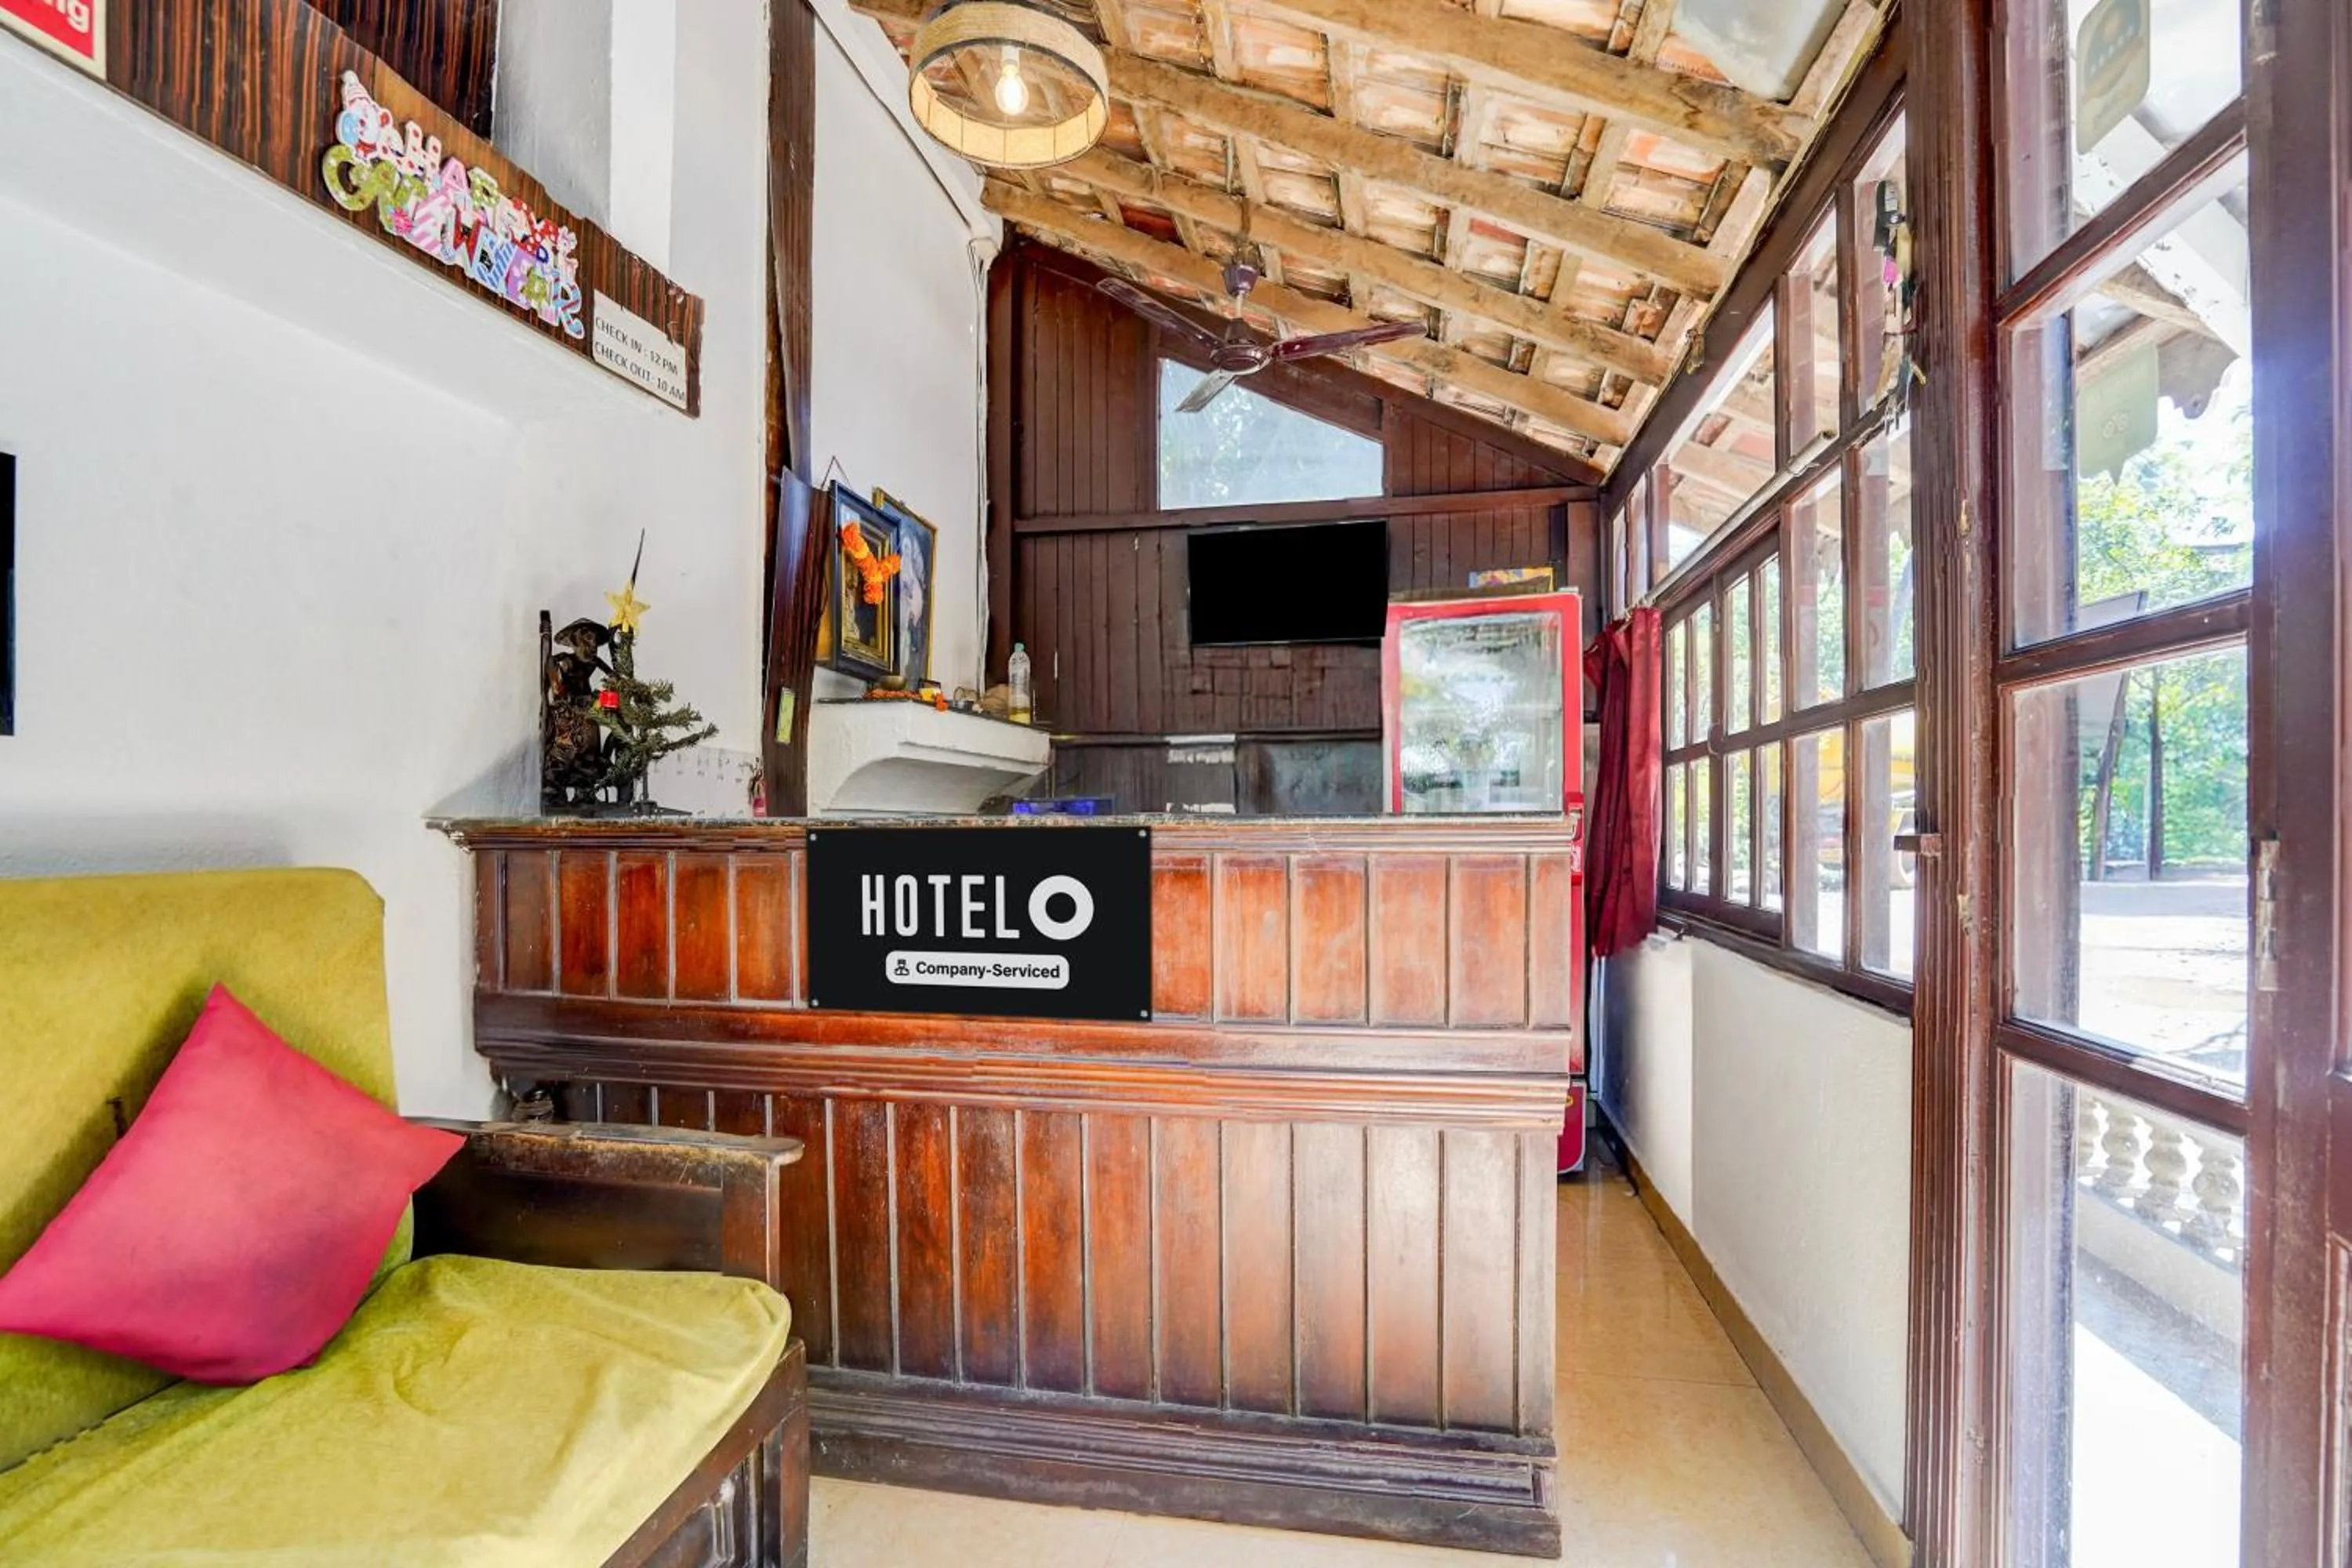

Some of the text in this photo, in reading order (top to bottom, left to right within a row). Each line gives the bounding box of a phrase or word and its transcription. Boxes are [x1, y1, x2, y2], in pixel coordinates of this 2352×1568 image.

[595, 342, 628, 368] CHECK
[630, 362, 650, 382] OUT
[657, 377, 667, 390] 10
[669, 386, 684, 401] AM
[596, 317, 628, 344] CHECK
[630, 339, 642, 353] IN
[650, 350, 661, 365] 12
[662, 358, 678, 375] PM
[862, 874, 1019, 938] HOTEL
[916, 961, 1060, 978] Company-Serviced
